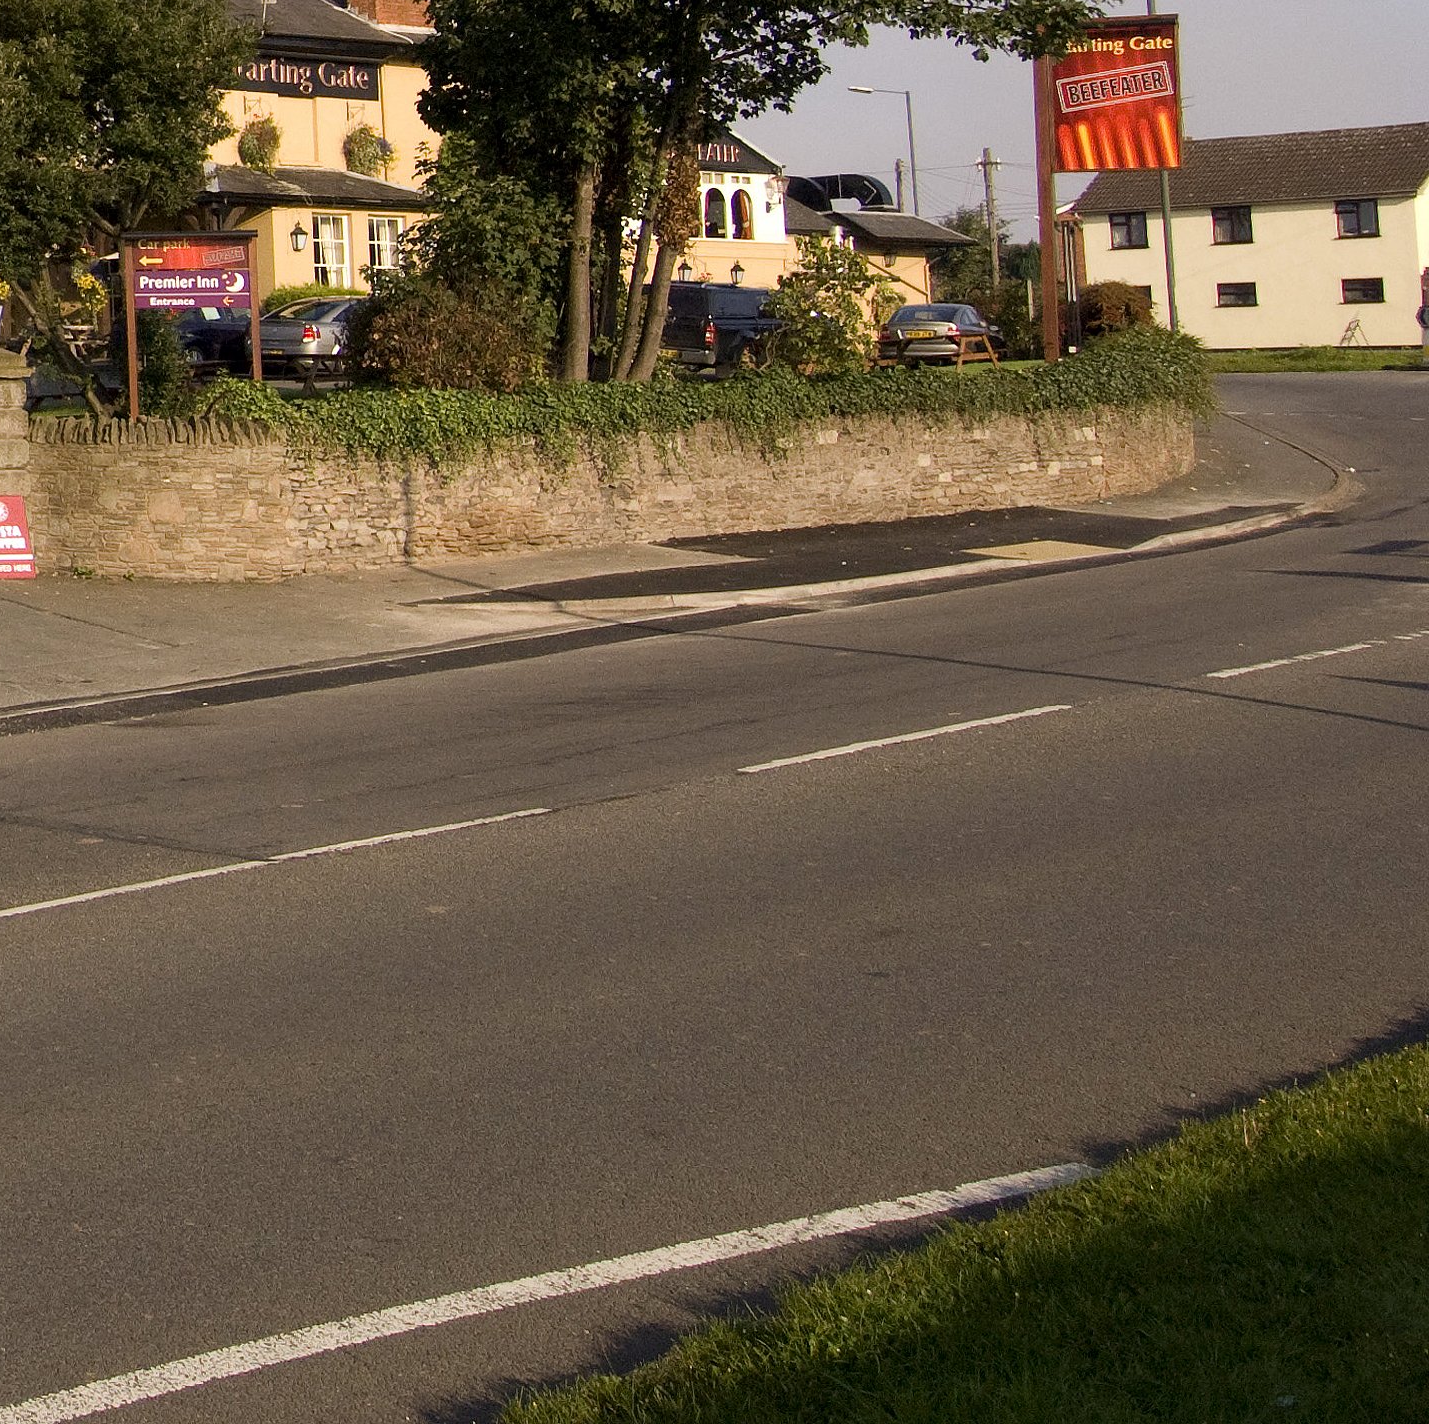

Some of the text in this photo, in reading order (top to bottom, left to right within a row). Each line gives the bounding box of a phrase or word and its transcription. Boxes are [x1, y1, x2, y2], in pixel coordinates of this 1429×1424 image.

[1129, 36, 1174, 51] Gate
[318, 62, 369, 90] Gate
[1067, 70, 1165, 105] BEEFEATER
[162, 238, 191, 253] park
[139, 275, 219, 289] Premier Inn
[149, 297, 195, 306] Entrance
